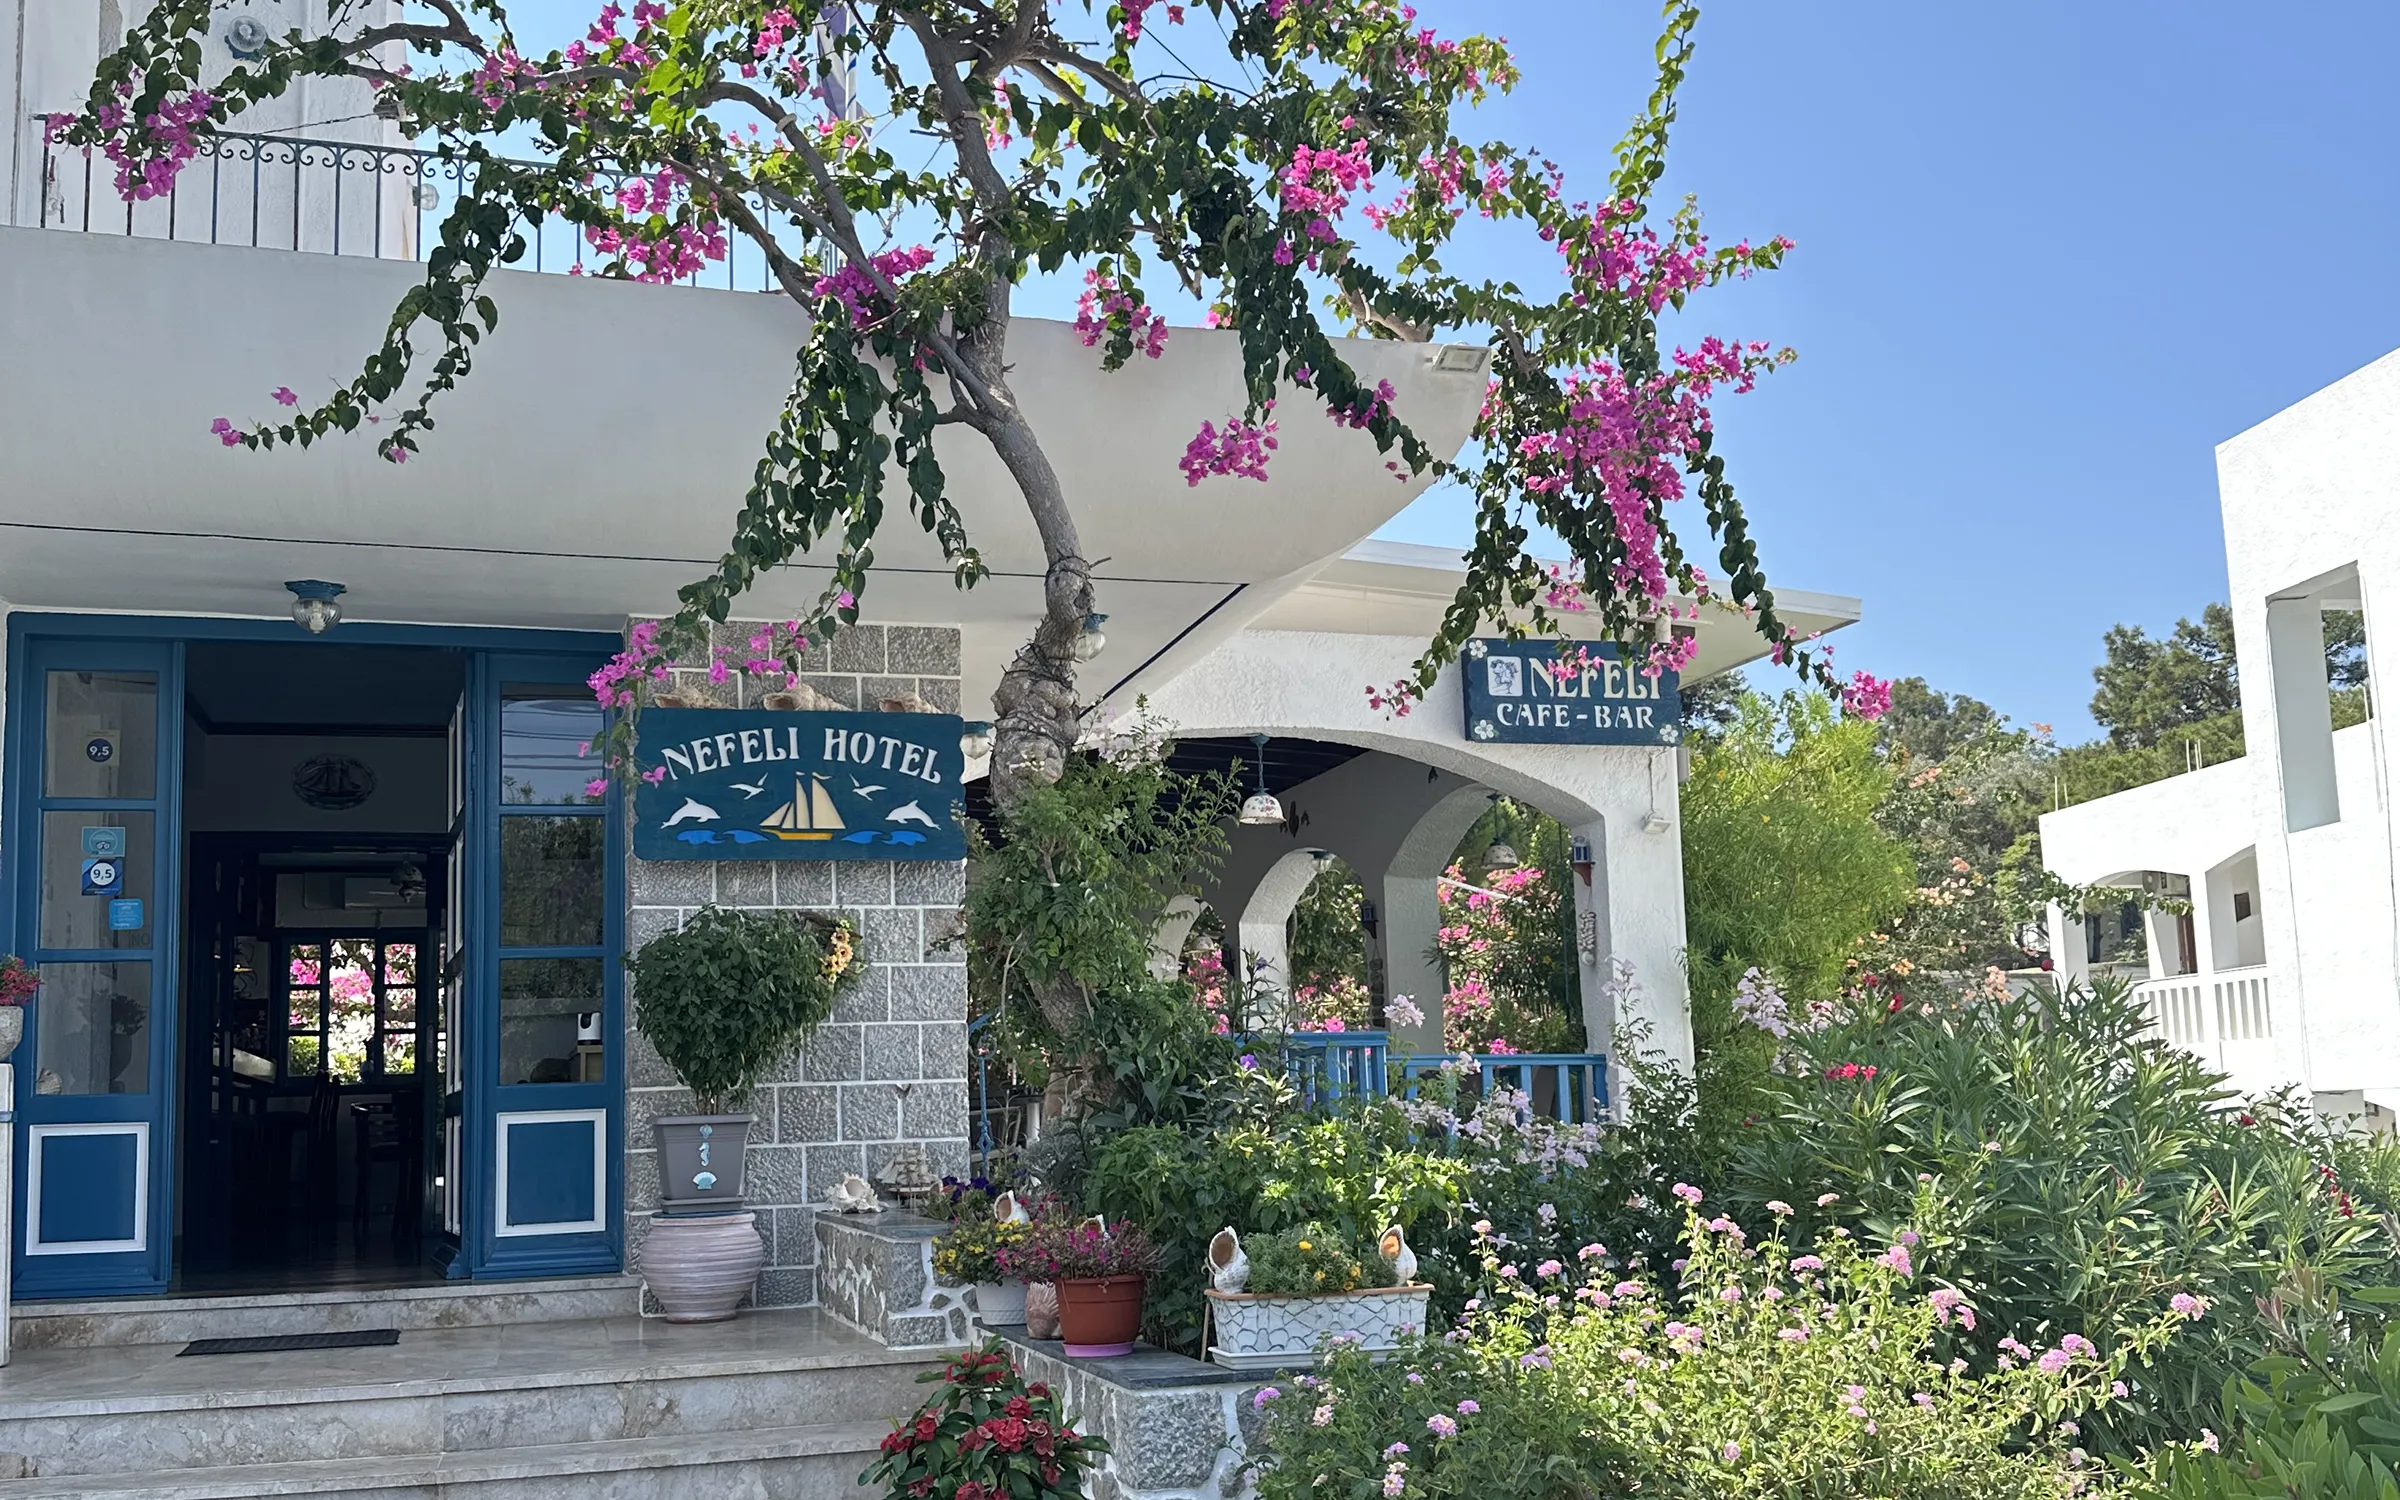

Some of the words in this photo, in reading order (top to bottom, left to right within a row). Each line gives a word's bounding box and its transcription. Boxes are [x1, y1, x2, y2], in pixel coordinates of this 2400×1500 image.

[89, 745, 110, 757] 9,5
[661, 727, 799, 781] NEFELI
[823, 727, 942, 785] HOTEL
[93, 868, 112, 880] 9,5
